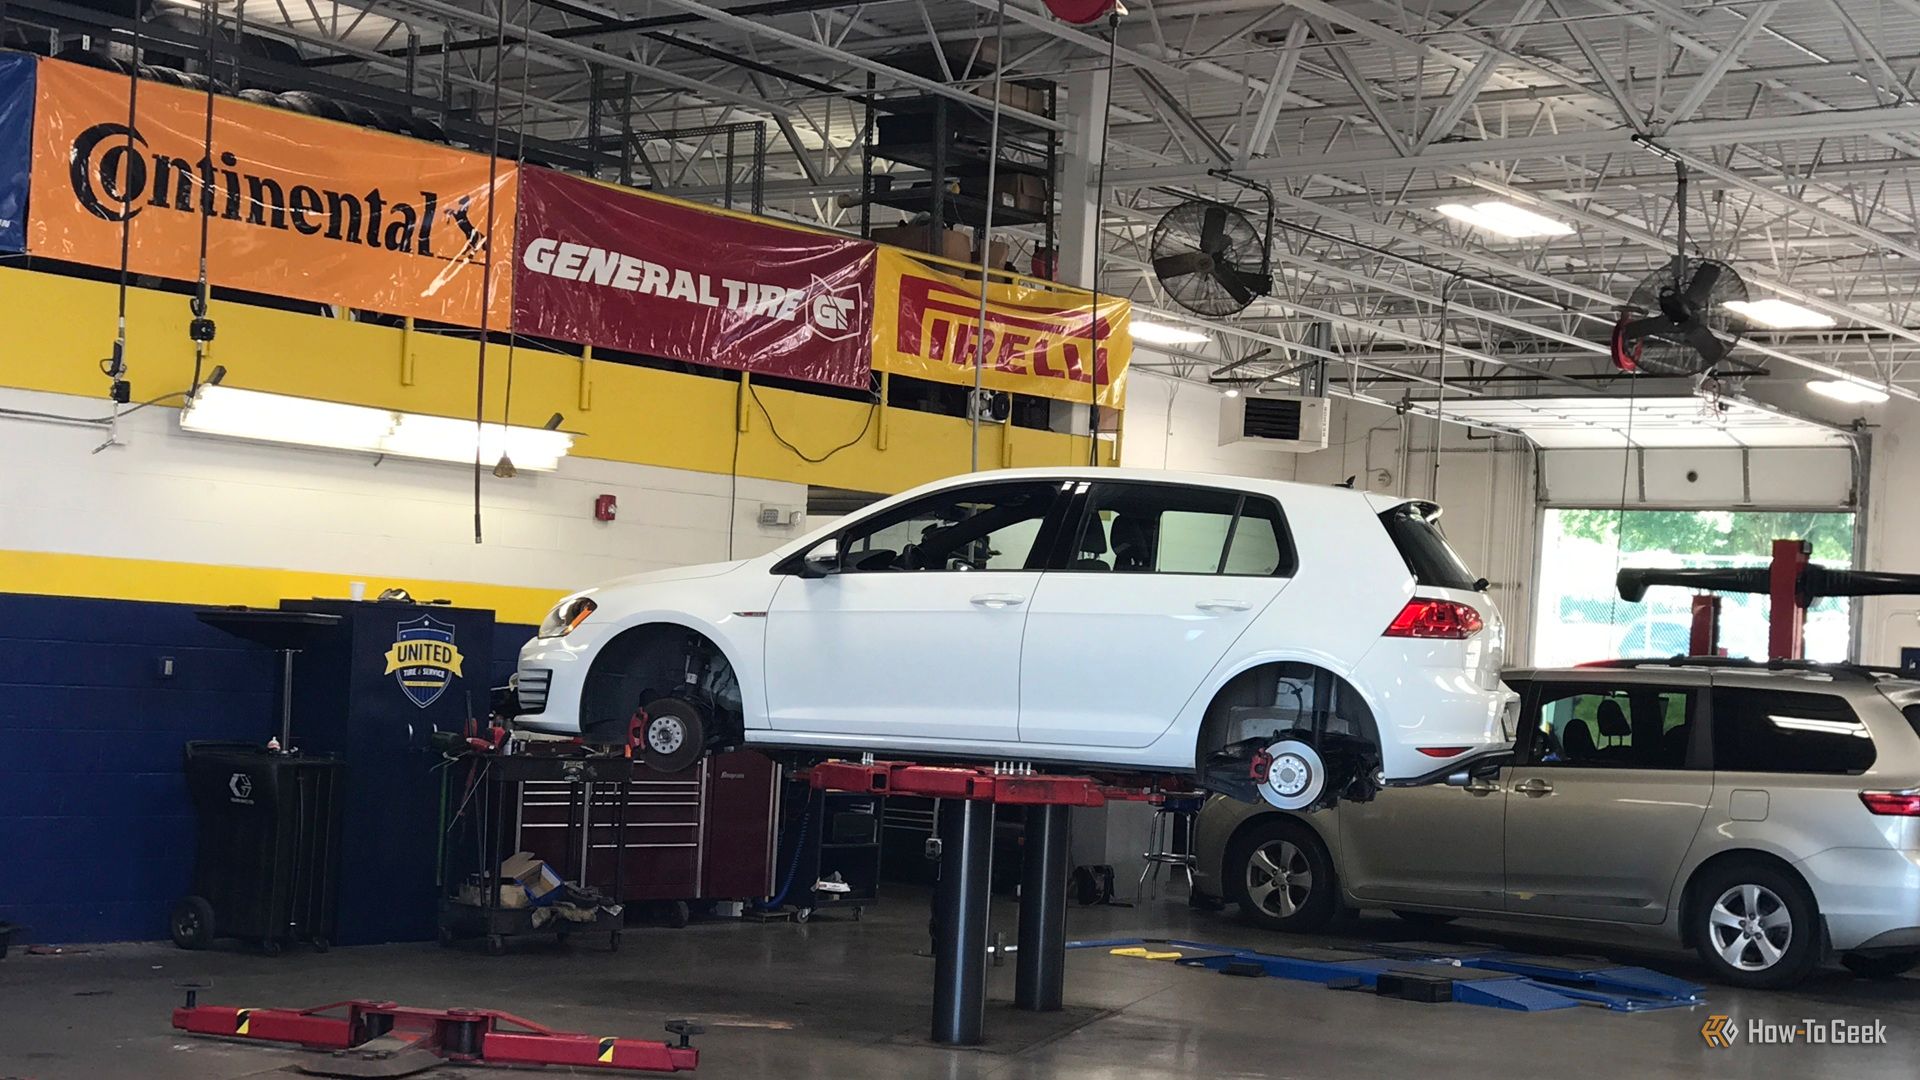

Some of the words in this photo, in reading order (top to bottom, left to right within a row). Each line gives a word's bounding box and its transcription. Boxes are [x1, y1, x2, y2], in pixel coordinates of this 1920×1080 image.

[69, 122, 437, 257] Continental
[523, 237, 719, 308] GENERAL
[721, 278, 808, 322] TIRE
[897, 274, 1111, 386] PIRELLI
[397, 643, 452, 664] UNITED
